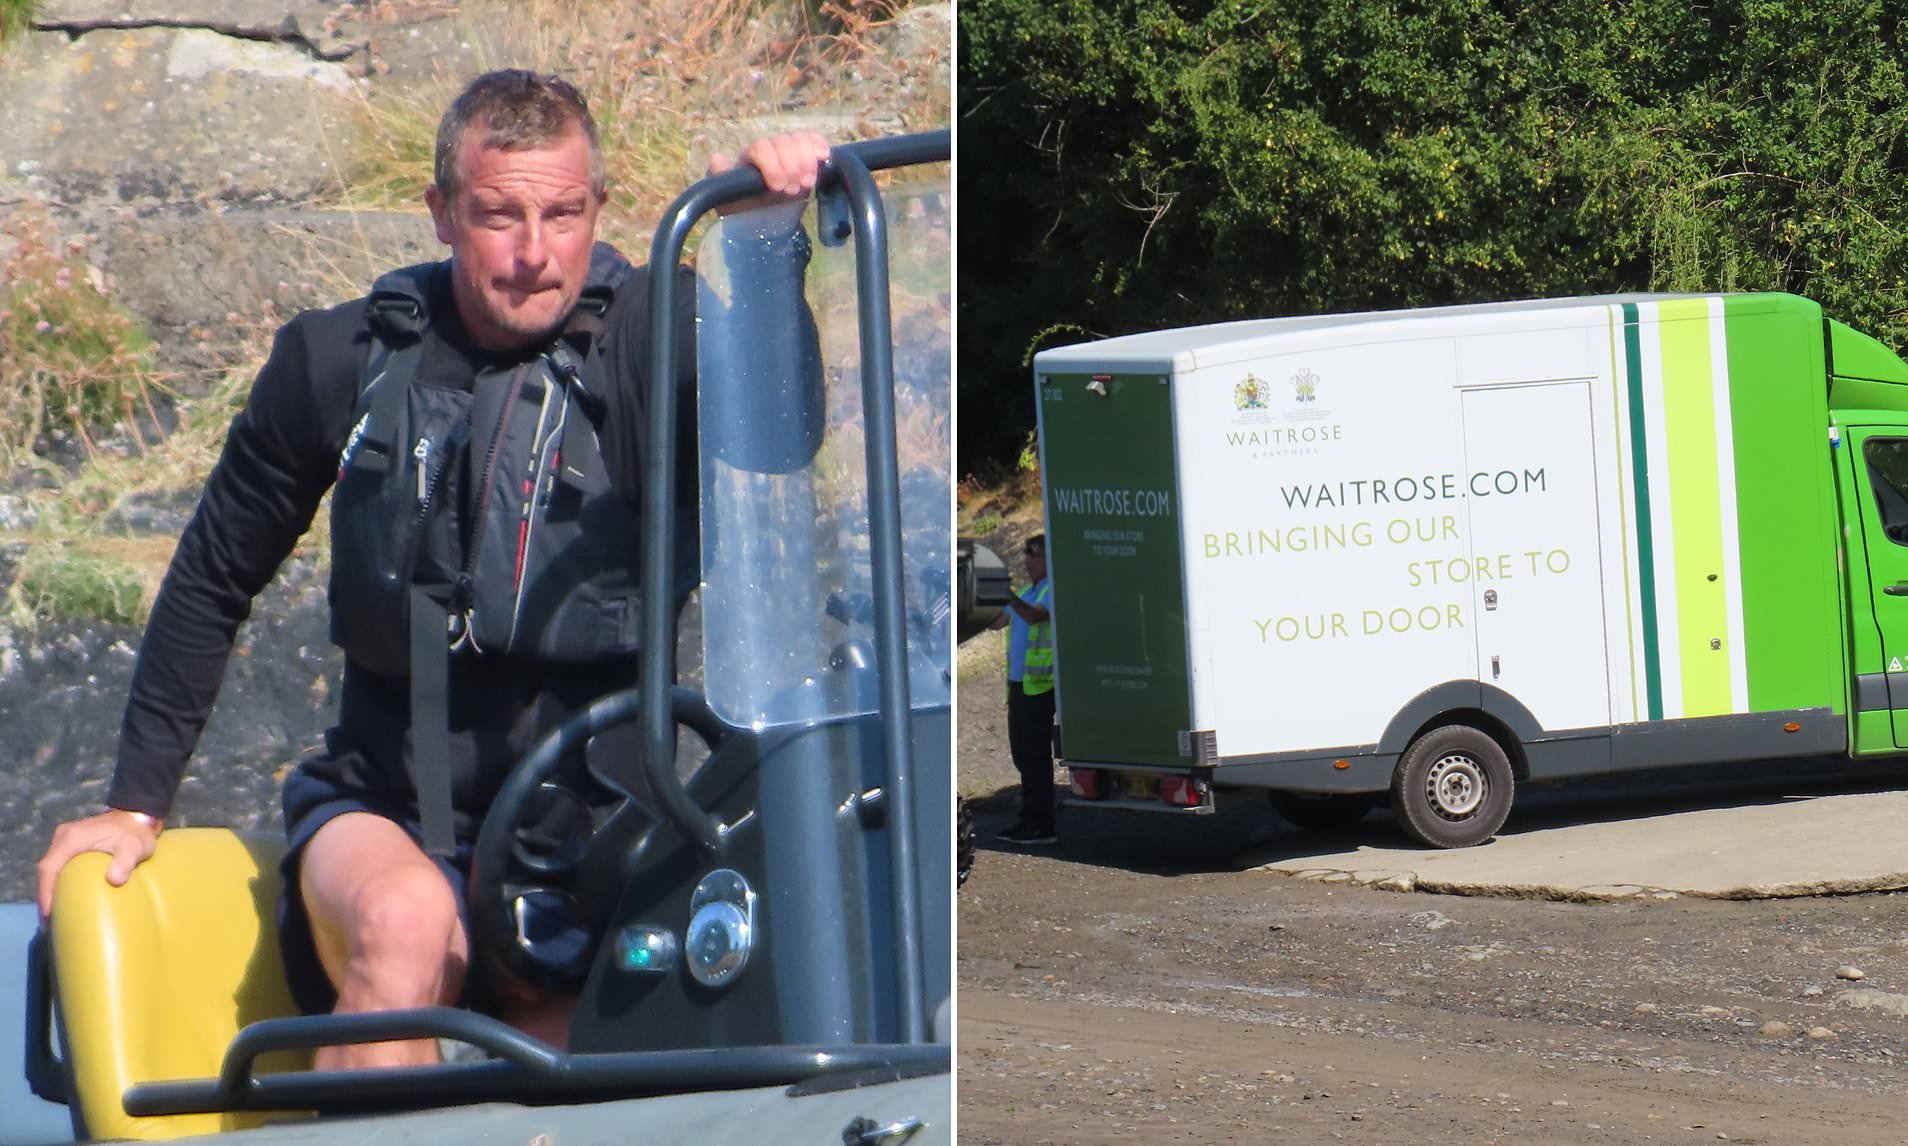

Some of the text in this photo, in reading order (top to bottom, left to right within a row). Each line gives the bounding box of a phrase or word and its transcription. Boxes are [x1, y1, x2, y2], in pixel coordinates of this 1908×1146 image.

[1226, 424, 1344, 447] WAITROSE
[1263, 447, 1319, 458] PARTNERS
[1054, 488, 1170, 516] WAITROSE.COM
[1281, 467, 1547, 509] WAITROSE.COM
[1203, 515, 1461, 558] BRINGING OUR
[1407, 548, 1571, 588] STORE TO
[1254, 603, 1465, 643] YOUR DOOR
